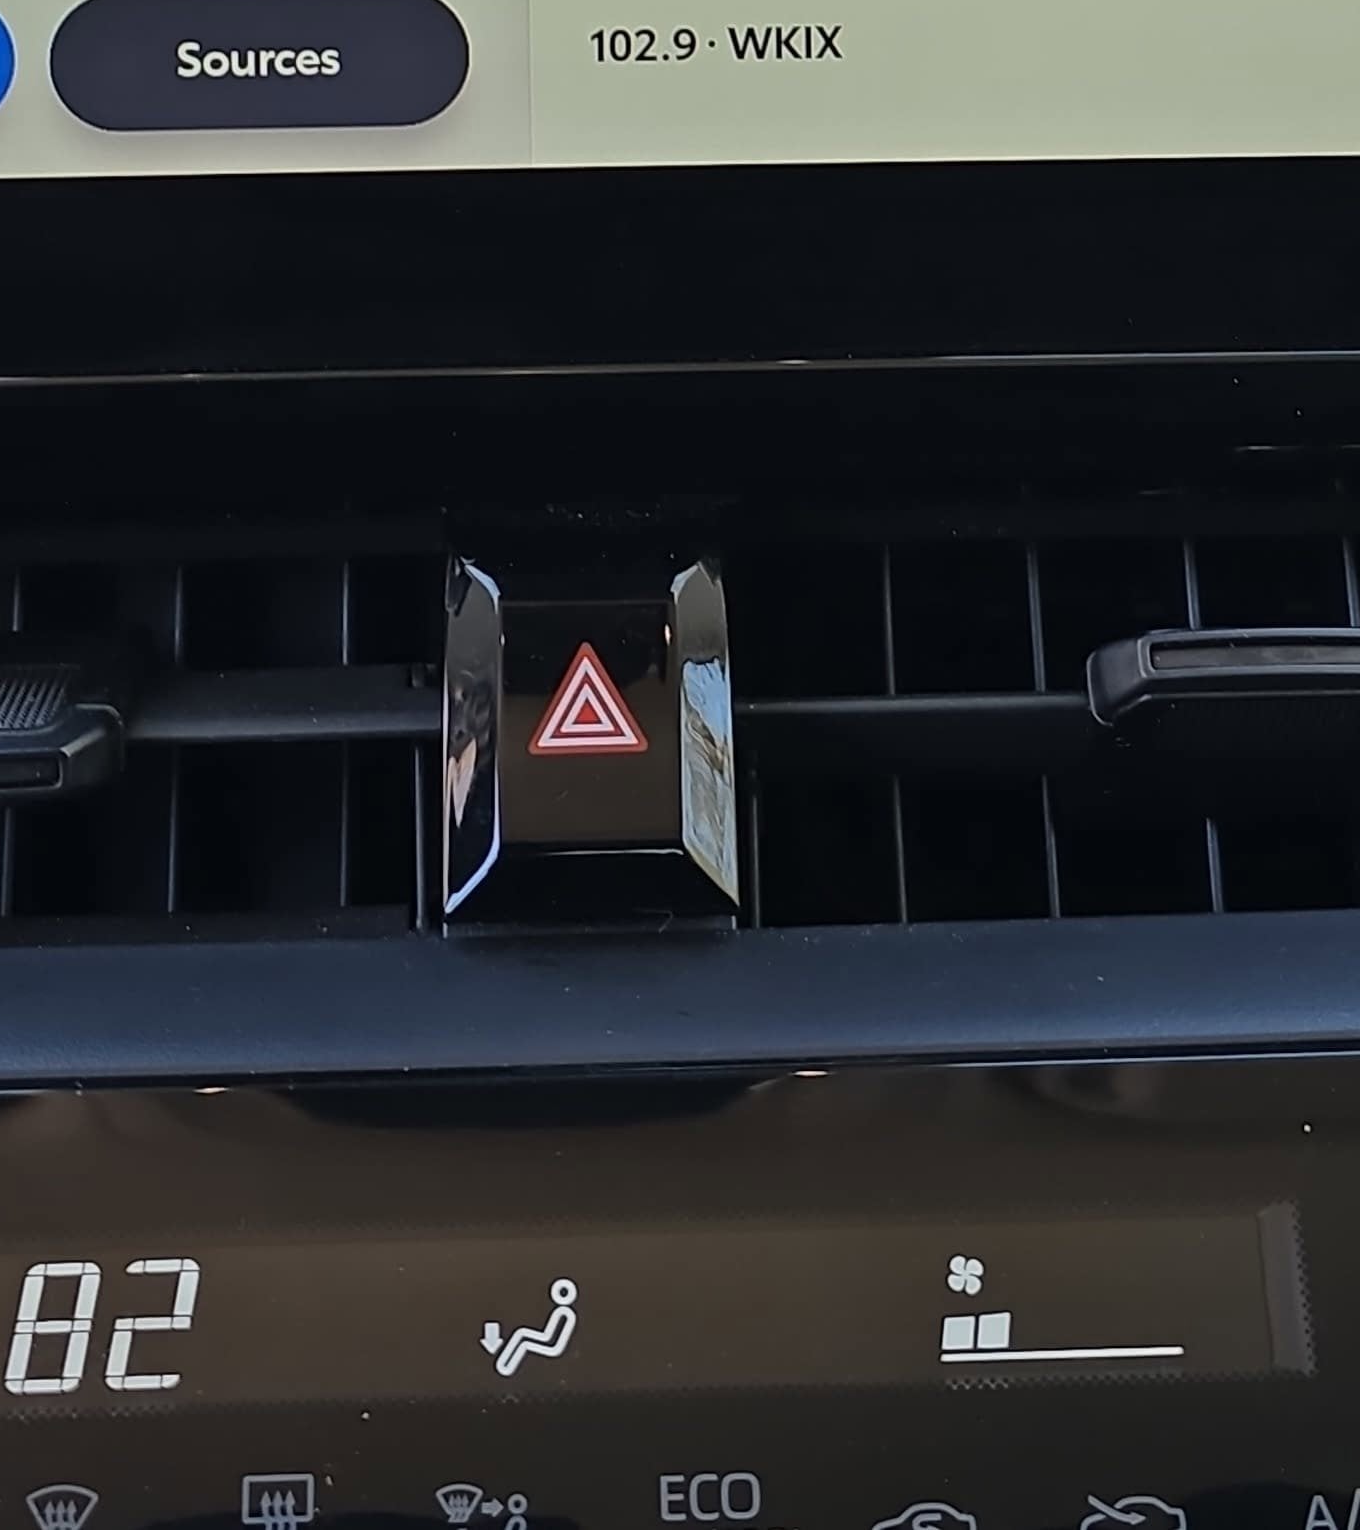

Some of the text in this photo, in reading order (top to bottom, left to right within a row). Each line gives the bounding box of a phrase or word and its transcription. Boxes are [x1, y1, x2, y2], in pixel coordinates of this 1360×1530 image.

[176, 40, 342, 79] Sources
[589, 27, 698, 64] 102.9
[726, 25, 844, 61] WKIX
[3, 1257, 202, 1395] 82
[659, 1471, 762, 1522] ECO
